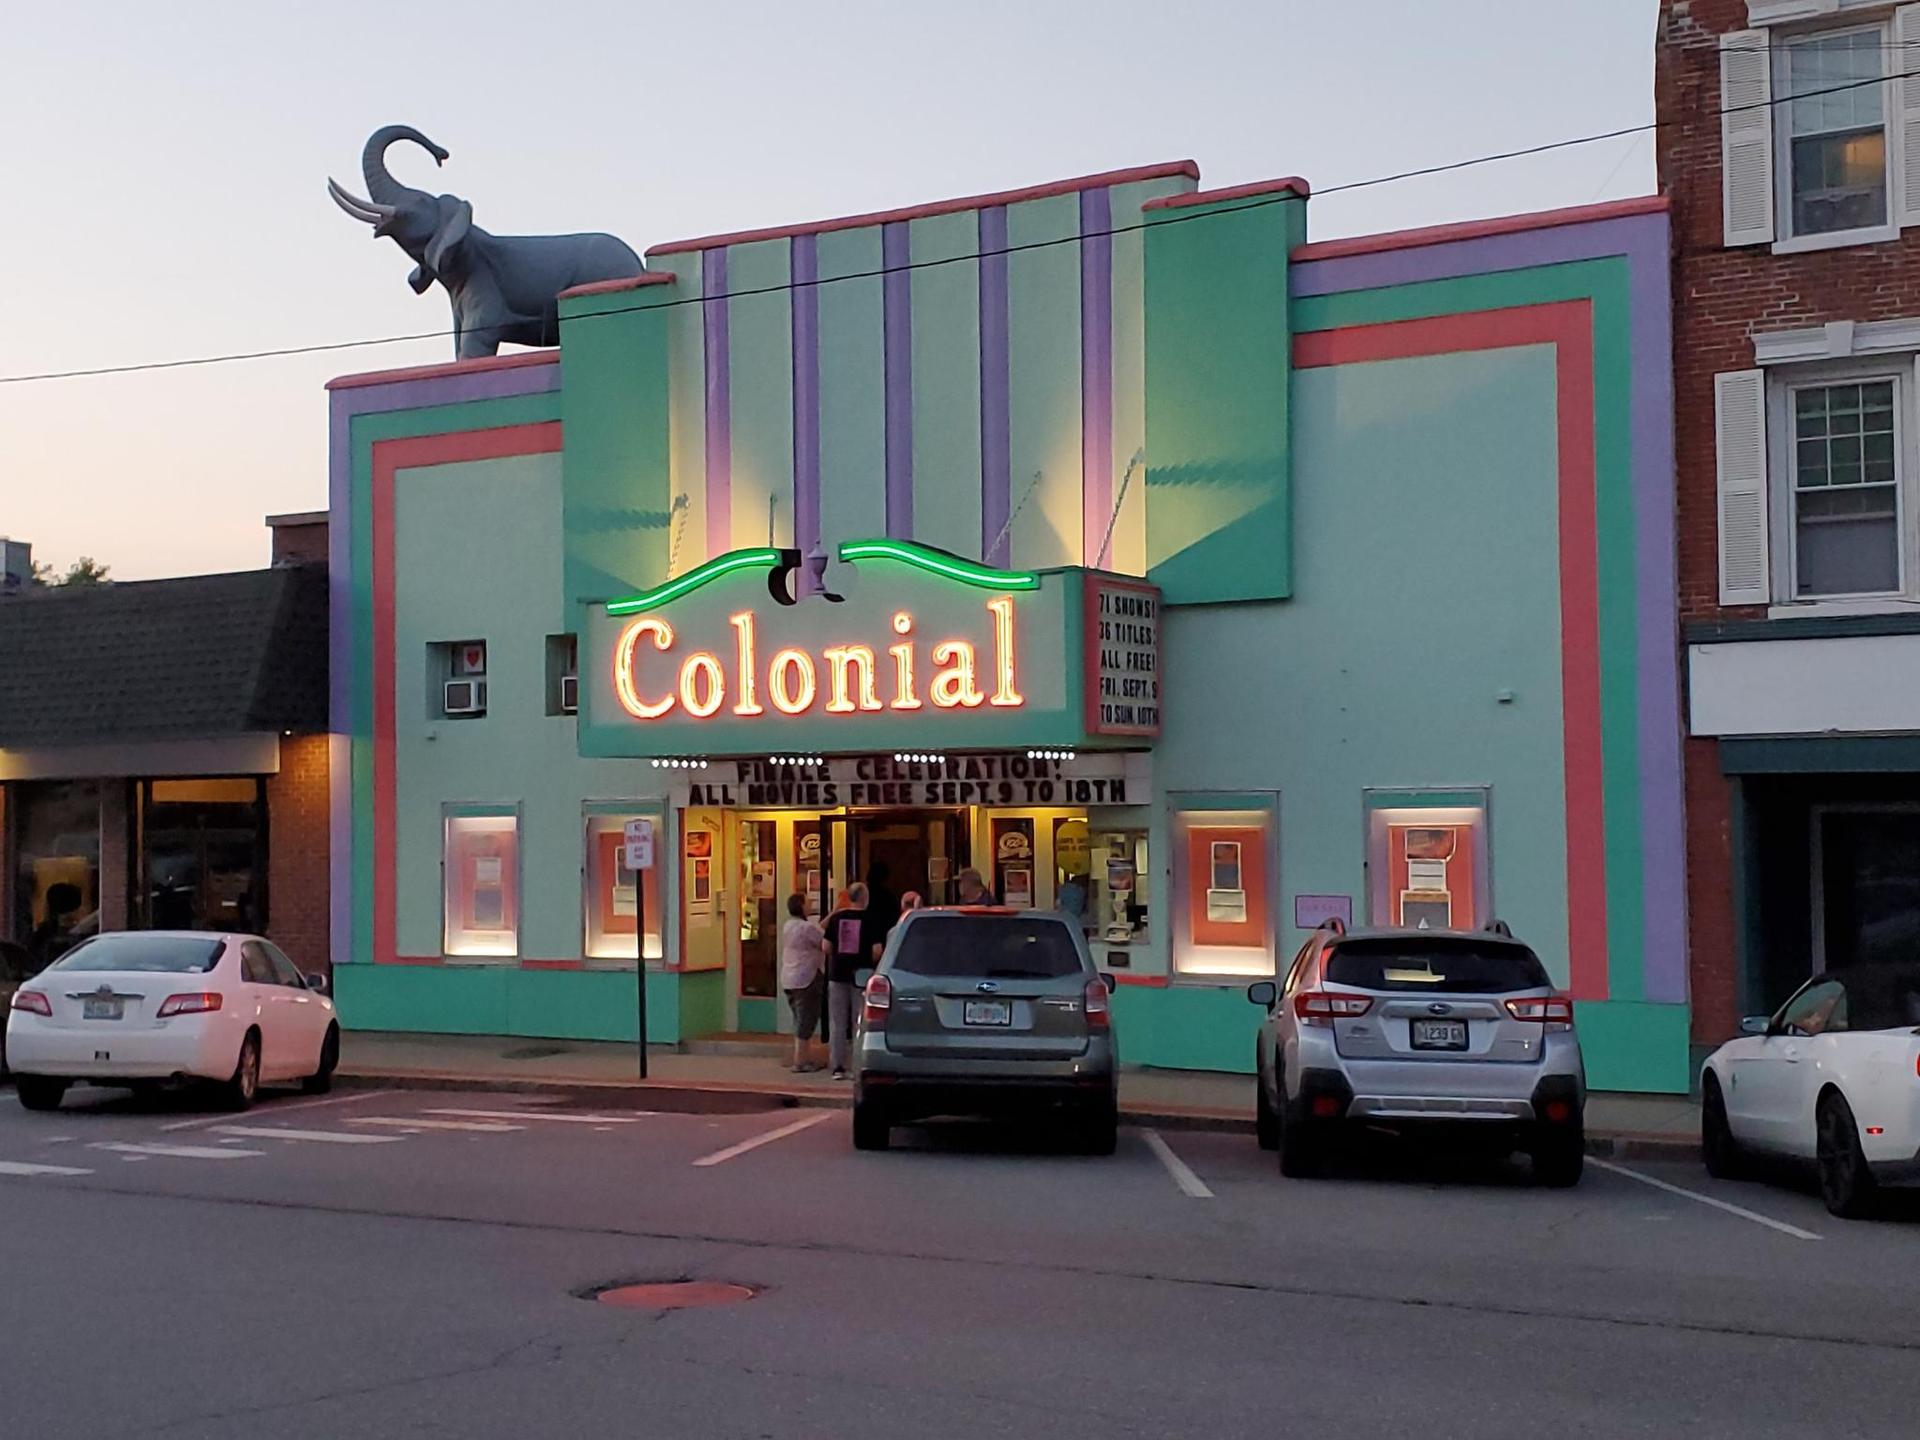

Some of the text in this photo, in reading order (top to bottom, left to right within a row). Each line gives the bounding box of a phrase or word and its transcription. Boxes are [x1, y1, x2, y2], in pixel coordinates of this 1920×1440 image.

[1099, 594, 1154, 618] 71 SHOWS!
[1099, 621, 1110, 640] 36
[613, 595, 1024, 718] Colonial
[1101, 650, 1155, 671] ALL FREE!
[1100, 677, 1119, 696] FRI.
[1100, 704, 1112, 722] TO
[737, 757, 1062, 782] FINALE CELEBRATION!
[689, 784, 735, 805] ALL
[750, 783, 837, 805] MOVIES
[851, 783, 912, 805] FREE
[1024, 780, 1054, 803] TO
[1065, 779, 1126, 802] 18TH
